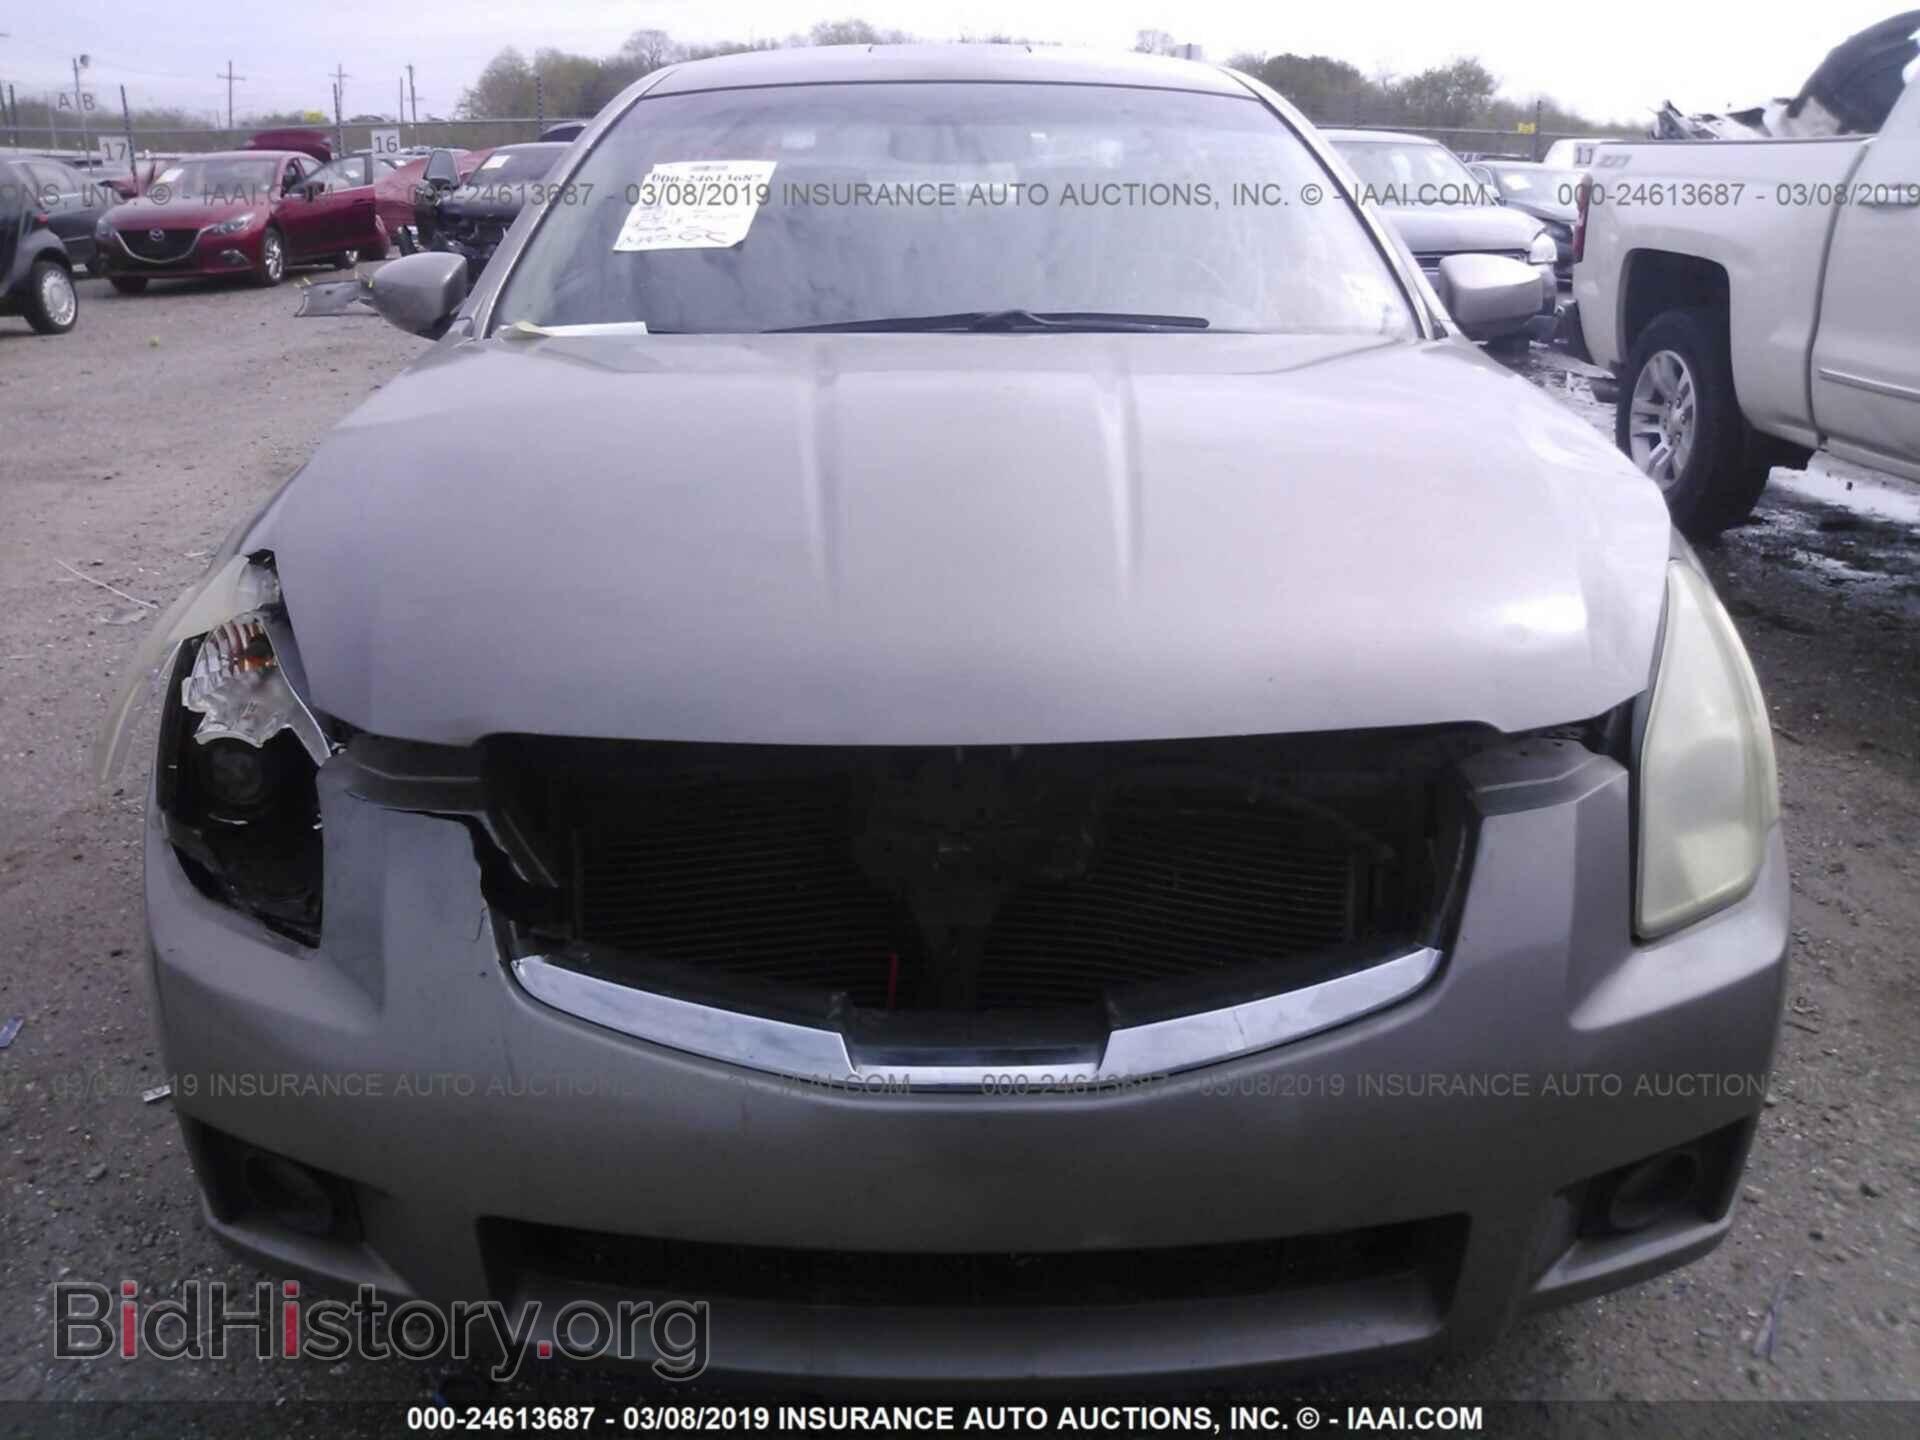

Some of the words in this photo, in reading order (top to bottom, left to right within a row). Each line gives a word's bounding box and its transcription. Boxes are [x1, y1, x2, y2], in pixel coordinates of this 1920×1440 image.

[58, 93, 72, 110] A
[82, 93, 96, 111] B
[103, 143, 127, 161] 17
[375, 136, 398, 153] 16
